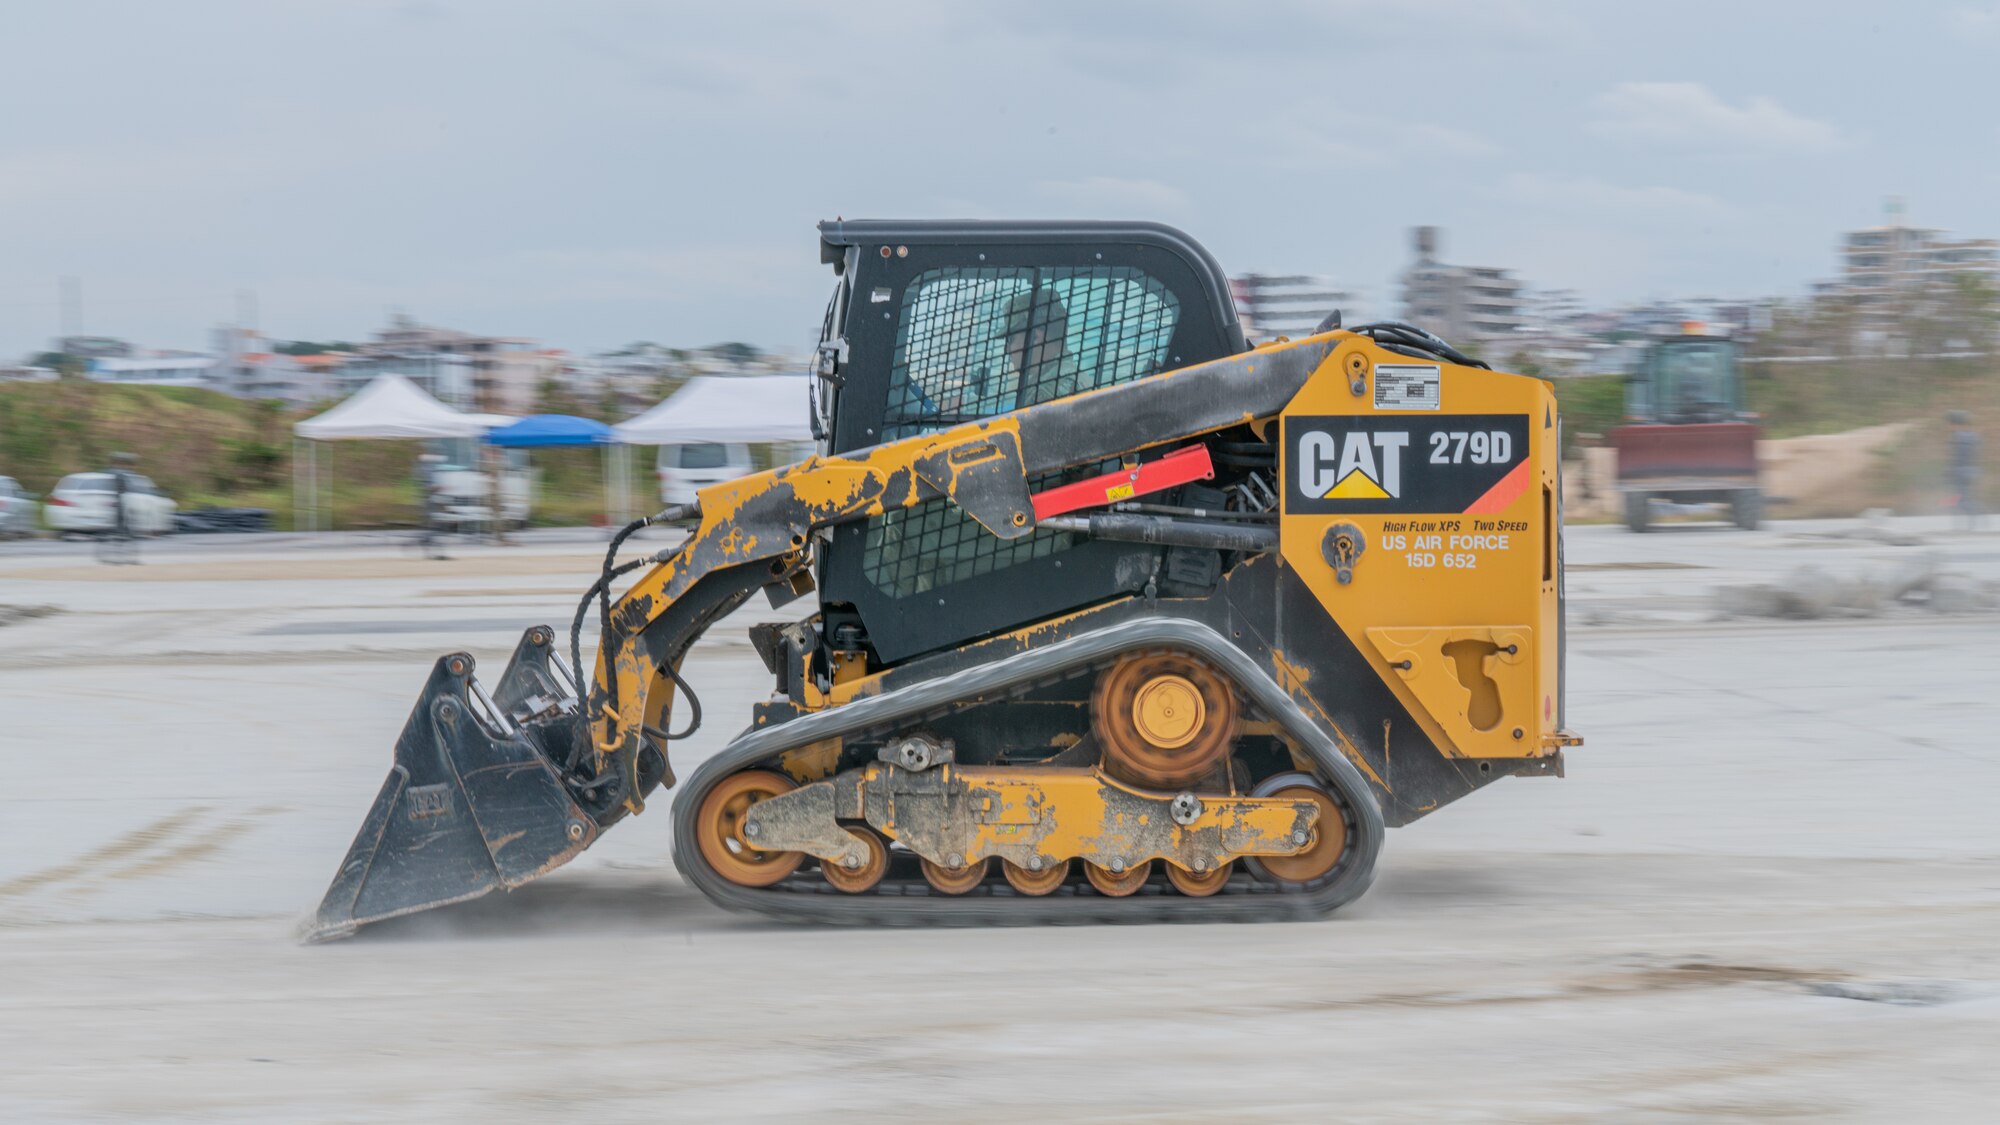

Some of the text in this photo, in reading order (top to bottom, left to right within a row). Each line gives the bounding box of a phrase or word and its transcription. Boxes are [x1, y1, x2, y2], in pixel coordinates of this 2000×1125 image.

[1429, 431, 1512, 464] 279D
[1299, 431, 1409, 499] CAT
[1439, 520, 1461, 532] XPS
[1382, 535, 1509, 550] US AIR FORCE
[1405, 553, 1476, 568] 15D 652
